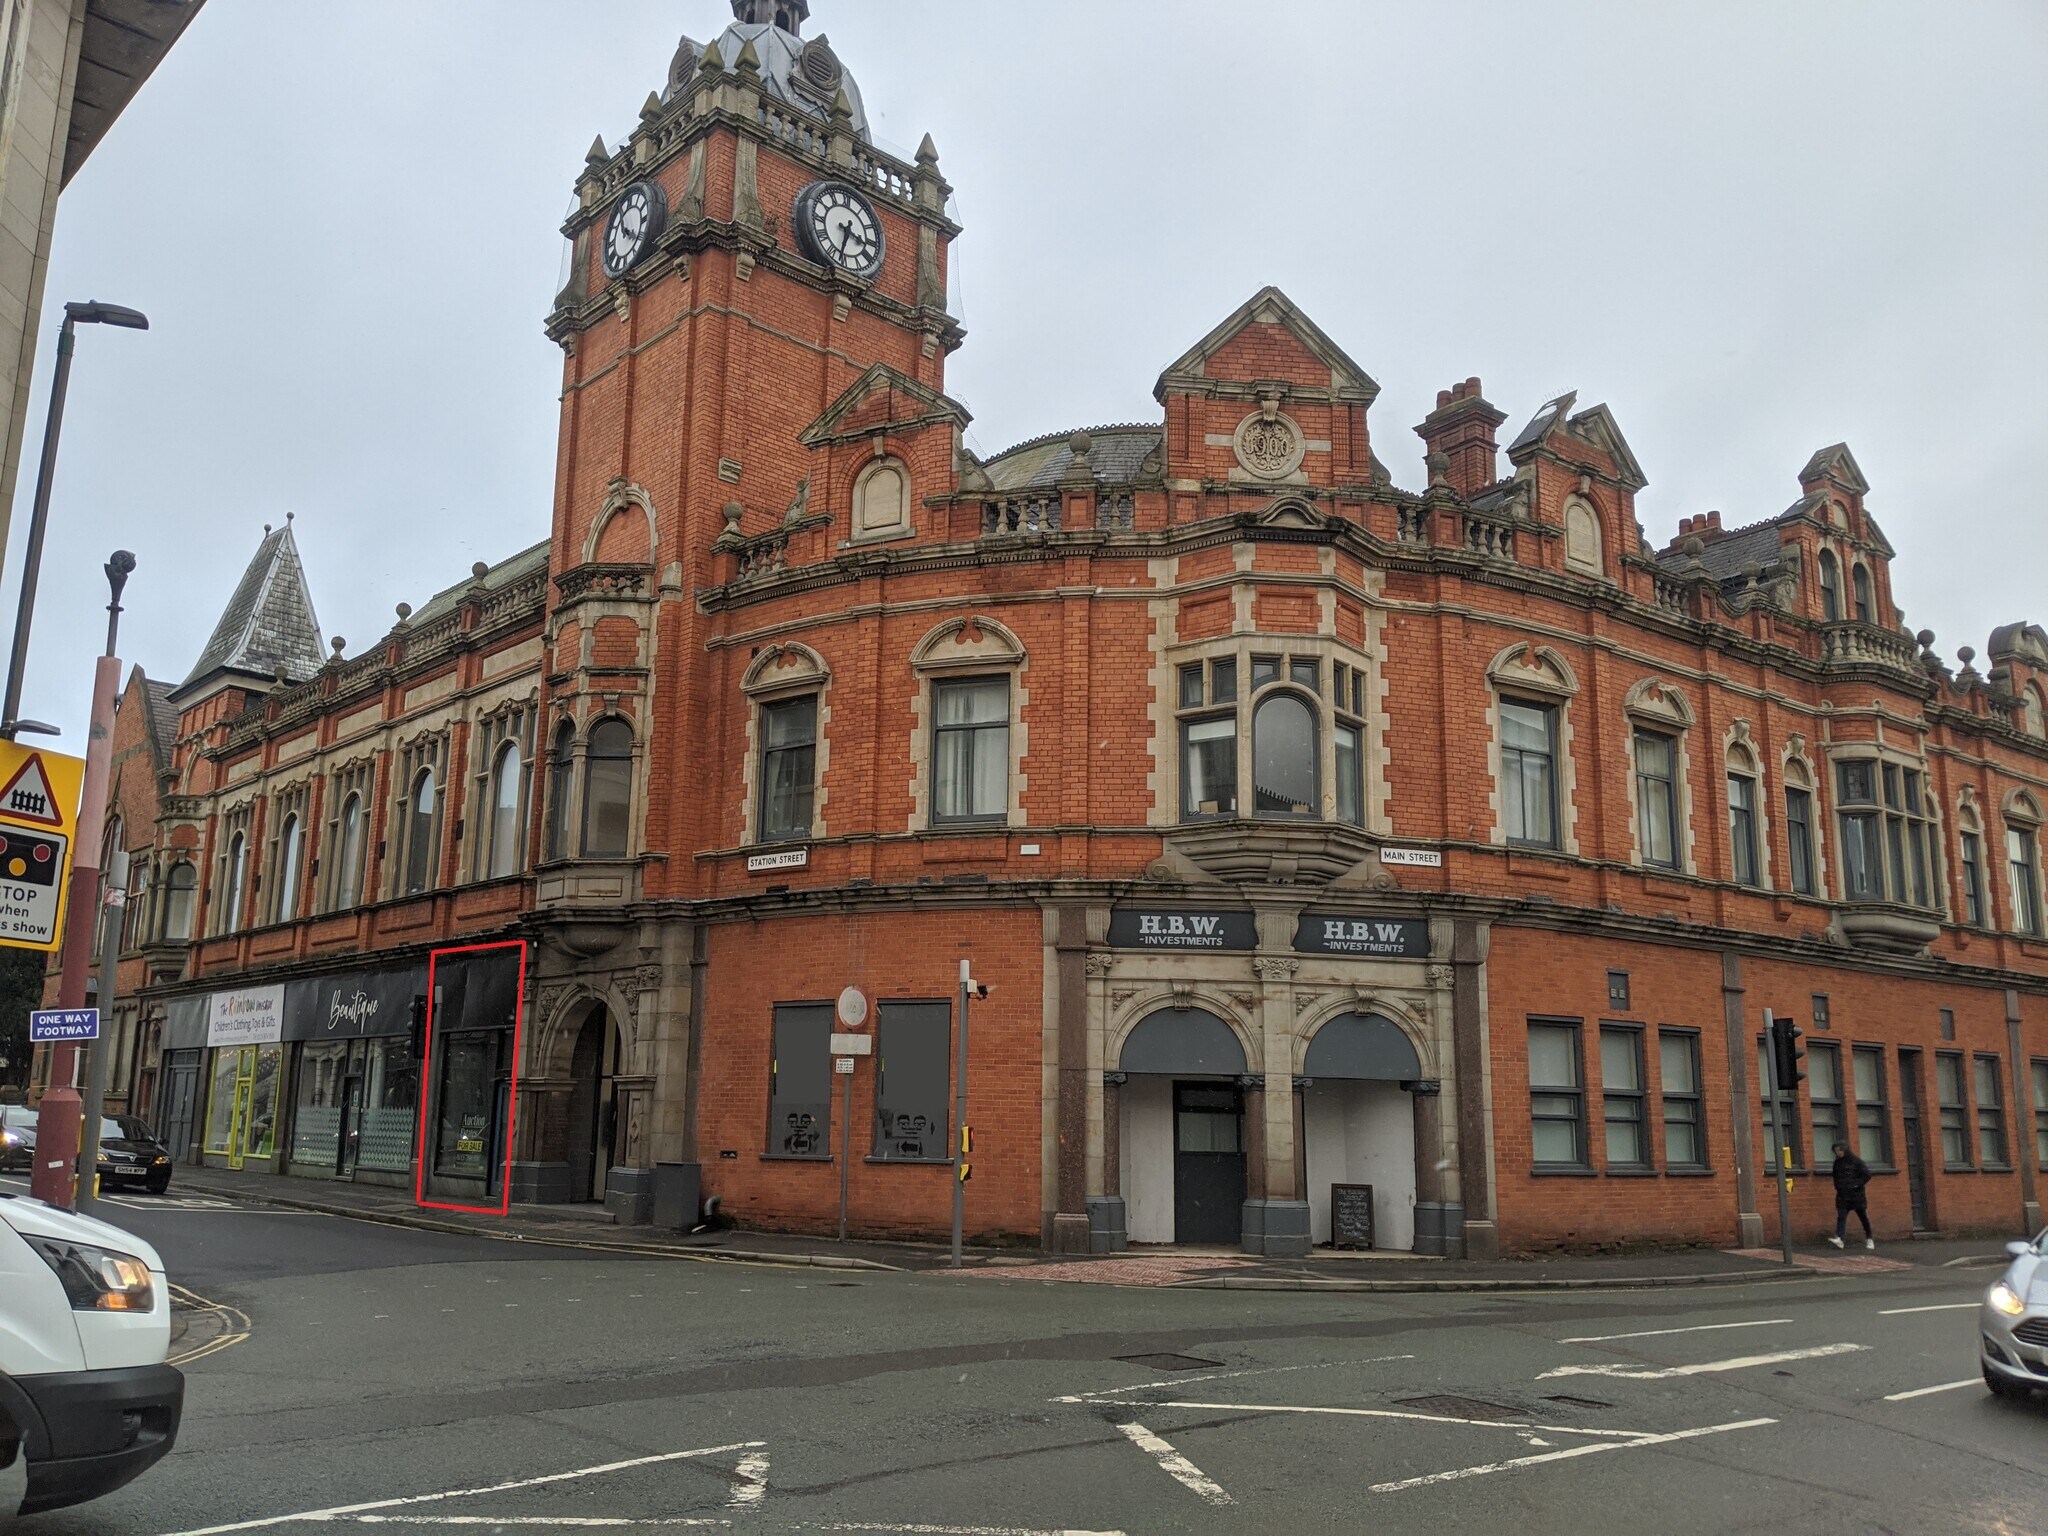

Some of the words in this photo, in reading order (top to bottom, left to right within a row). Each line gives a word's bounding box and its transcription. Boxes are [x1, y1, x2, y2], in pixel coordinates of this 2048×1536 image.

[750, 857, 777, 867] STATION
[779, 854, 804, 864] STREET
[1384, 851, 1405, 861] MAIN
[1409, 853, 1438, 863] STREET
[0, 886, 37, 902] TOP
[13, 921, 47, 935] show
[1139, 915, 1224, 935] H.B.W.
[1323, 921, 1405, 943] H.B.W.
[328, 989, 379, 1034] Beautique
[38, 1015, 61, 1024] ONE
[65, 1013, 91, 1023] WAY
[37, 1025, 92, 1037] FOOTWAY
[458, 1141, 469, 1150] FOR
[469, 1141, 482, 1151] SALE
